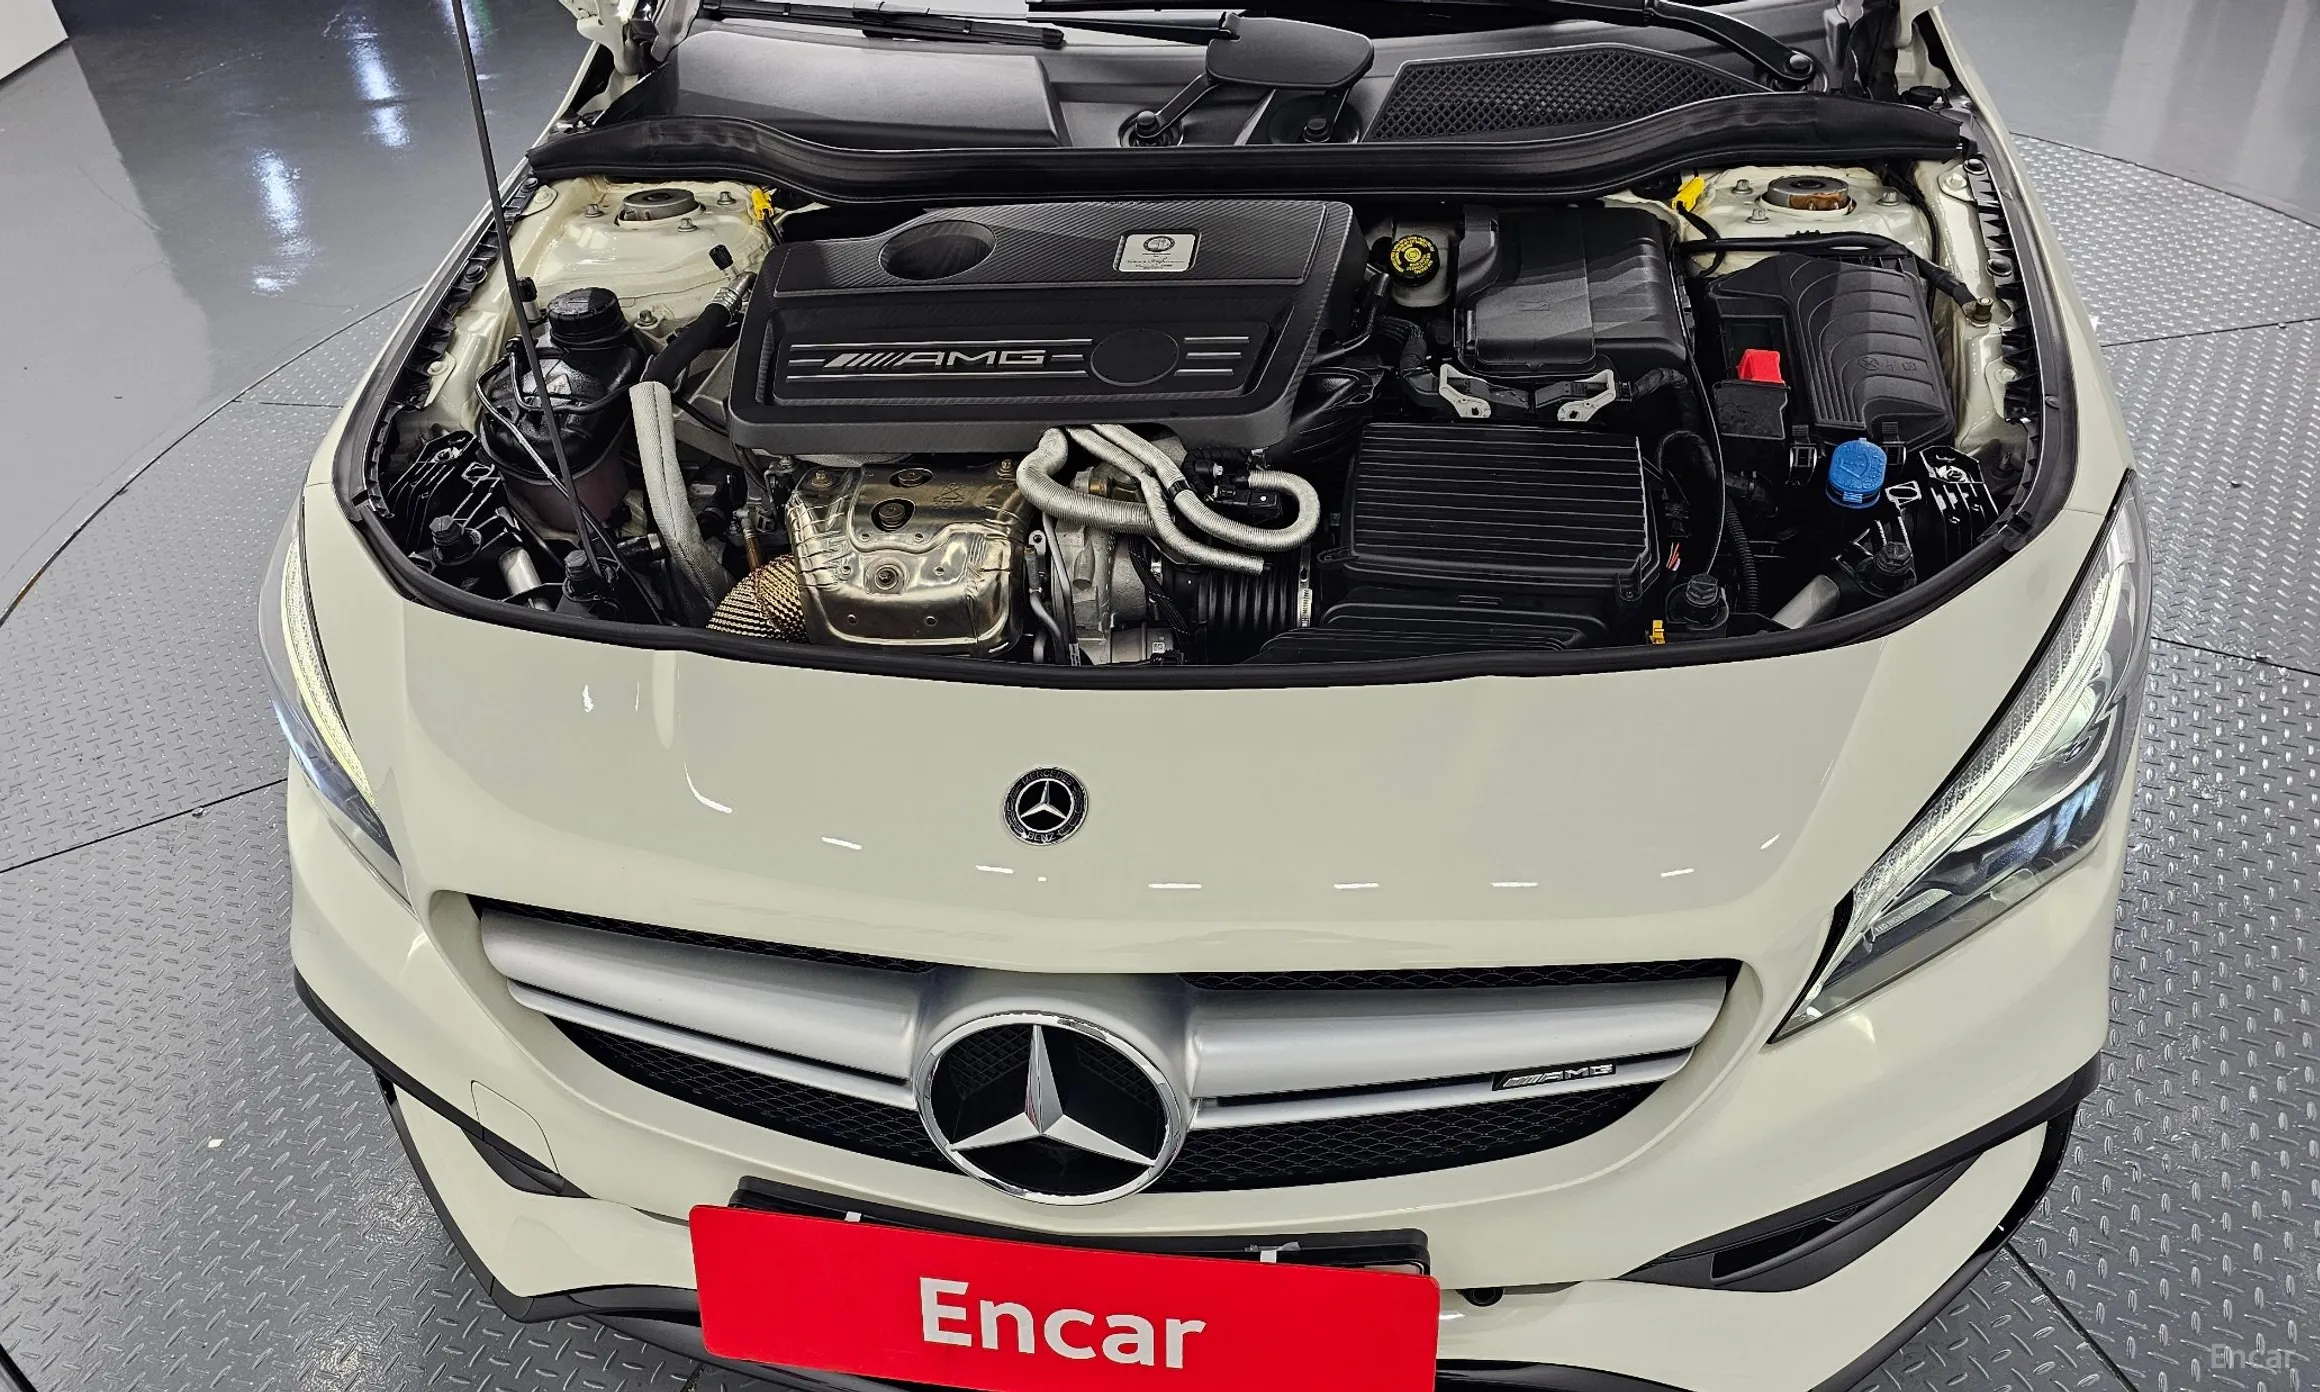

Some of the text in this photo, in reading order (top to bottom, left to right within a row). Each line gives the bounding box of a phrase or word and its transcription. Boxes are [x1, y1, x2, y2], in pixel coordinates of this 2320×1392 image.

[893, 350, 1046, 368] AMG
[1021, 769, 1075, 786] MERCEDES
[1028, 832, 1057, 842] BENZ
[1537, 1063, 1613, 1083] AMG
[919, 1276, 1207, 1369] Encar
